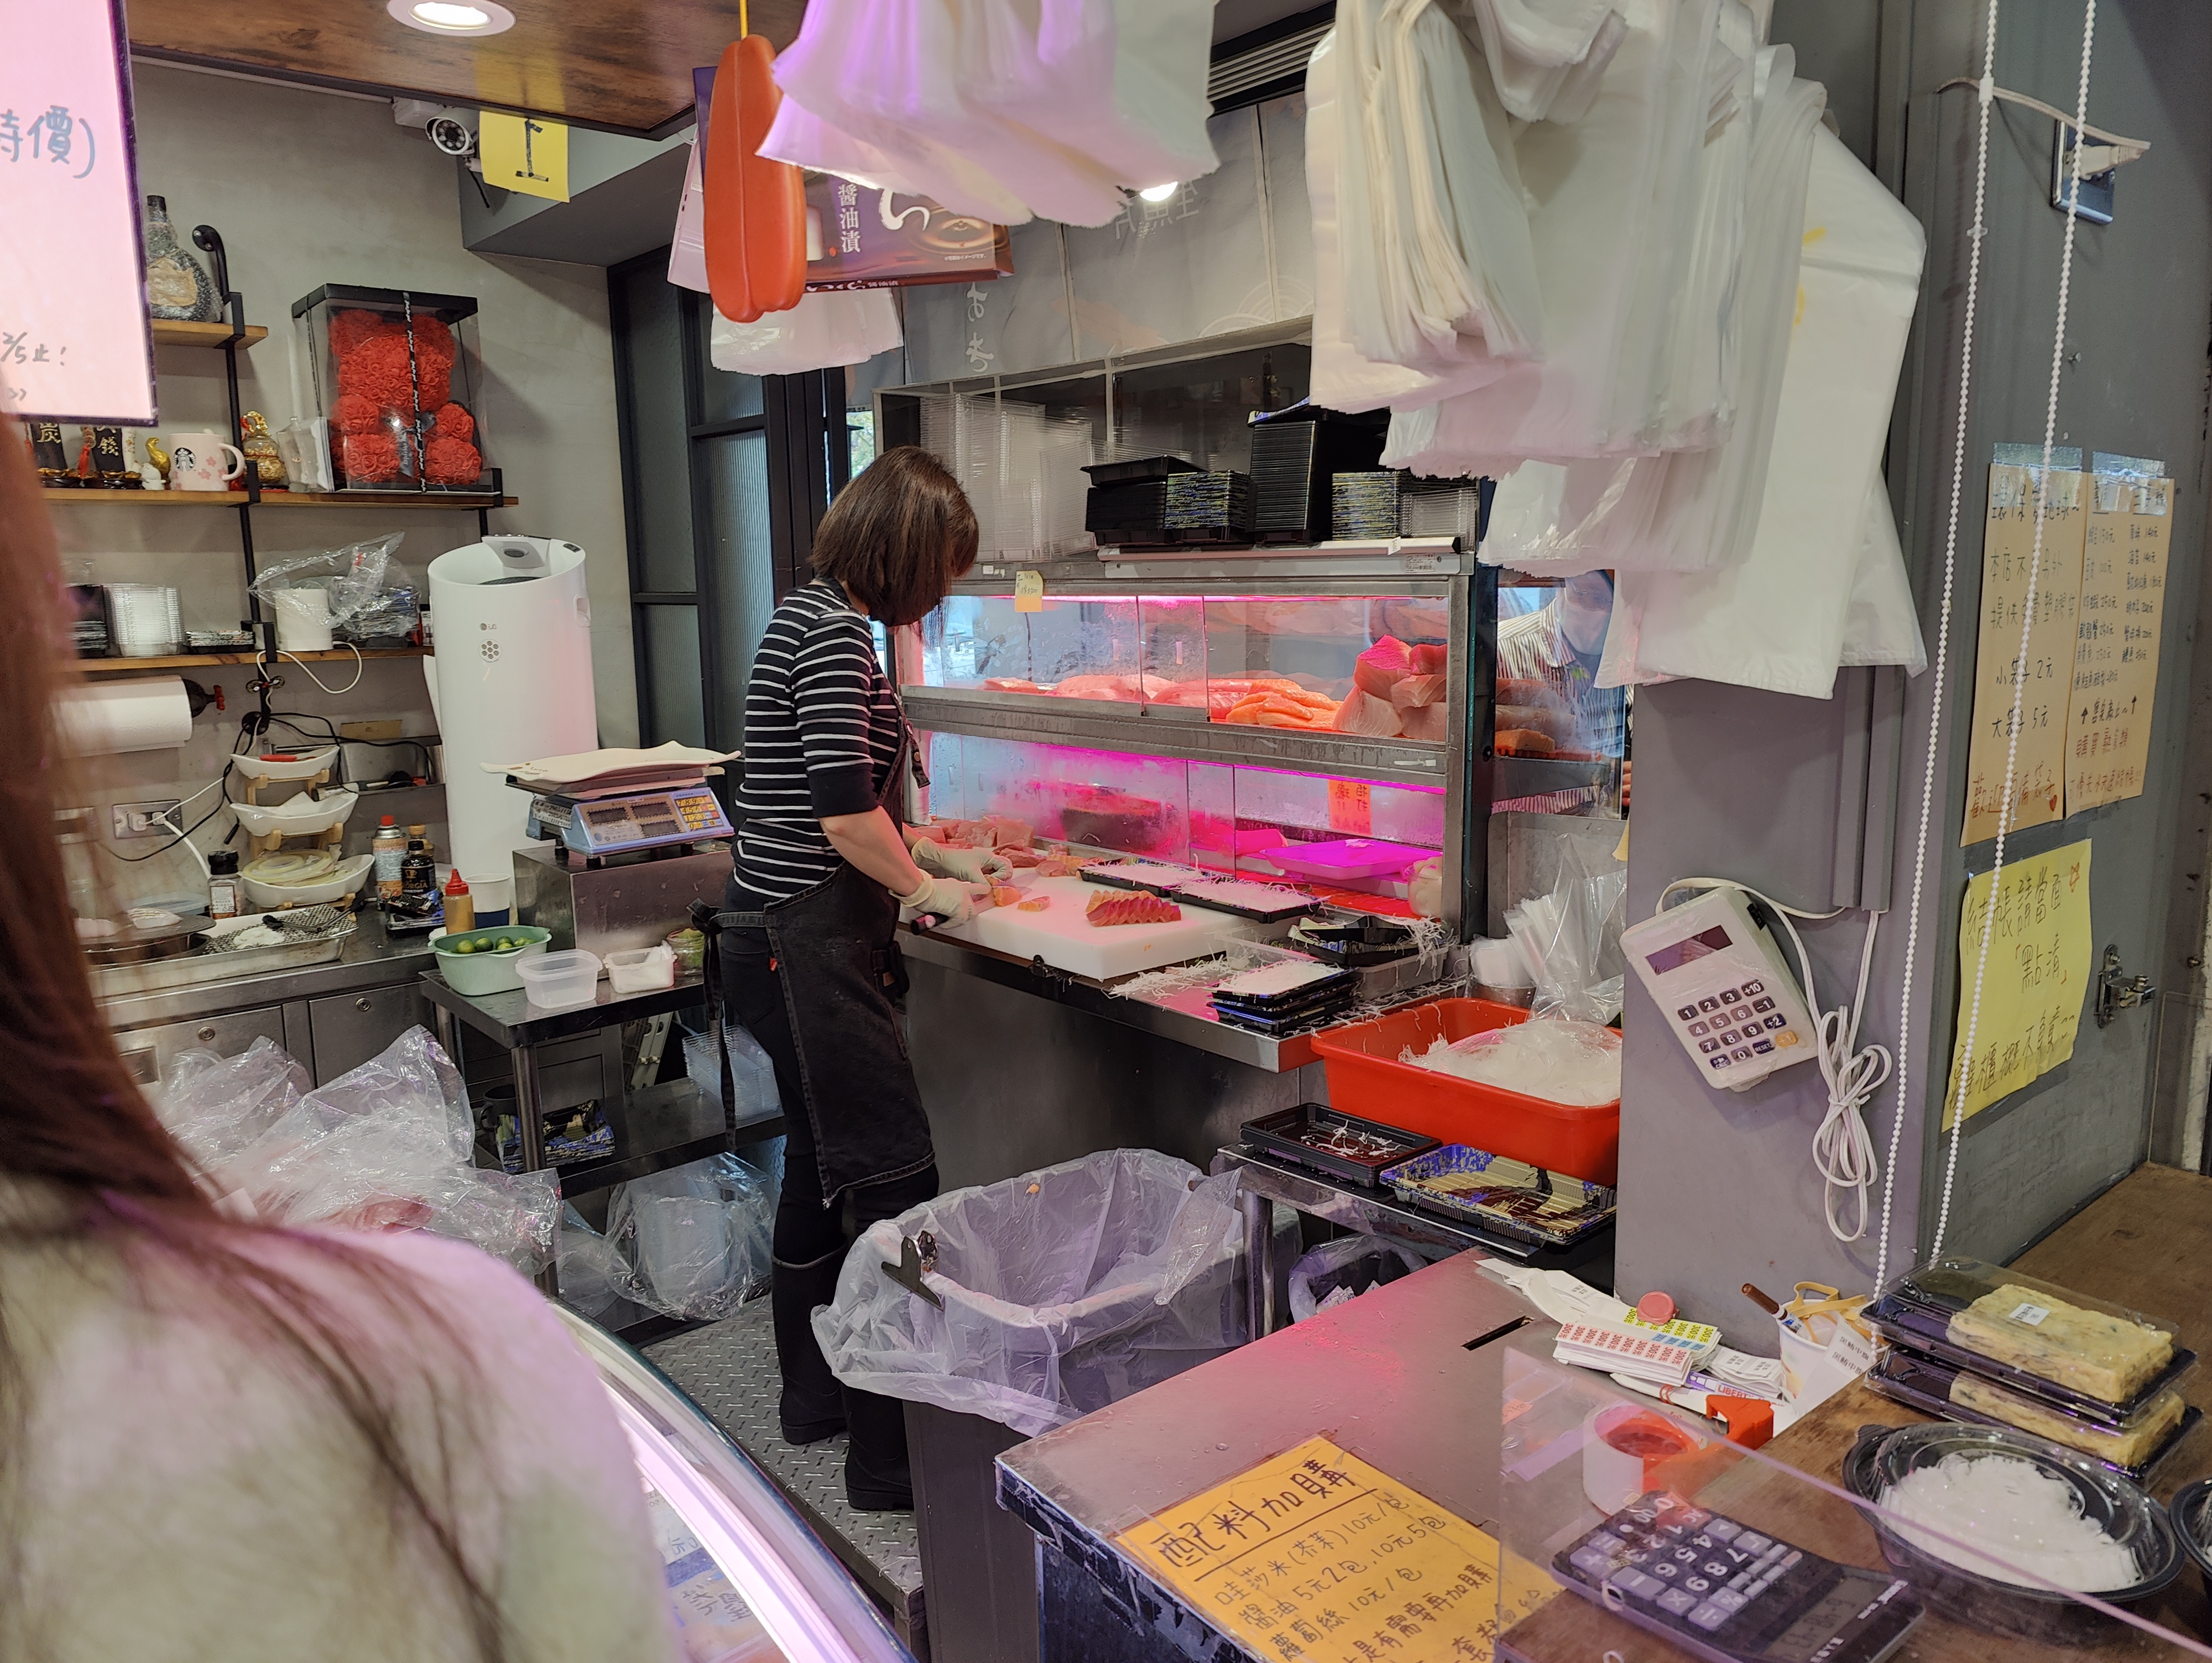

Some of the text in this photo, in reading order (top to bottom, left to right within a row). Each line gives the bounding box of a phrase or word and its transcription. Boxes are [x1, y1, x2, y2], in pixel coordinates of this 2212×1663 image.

[1990, 547, 2063, 582] 本店不另外
[2037, 657, 2053, 679] 2元
[2032, 705, 2048, 729] 5元
[1684, 982, 1761, 1018] 1 2 3 +10
[1695, 1026, 1703, 1034] 4
[1715, 1018, 1724, 1027] 5
[1737, 1010, 1746, 1018] 6
[1704, 1042, 1713, 1051] 7
[1726, 1034, 1735, 1043] 8
[1748, 1026, 1757, 1035] 9
[1738, 1050, 1746, 1059] 0
[1754, 1043, 1771, 1052] RESET
[1151, 1459, 1357, 1568] 配料加購
[1704, 1561, 1728, 1577] 8
